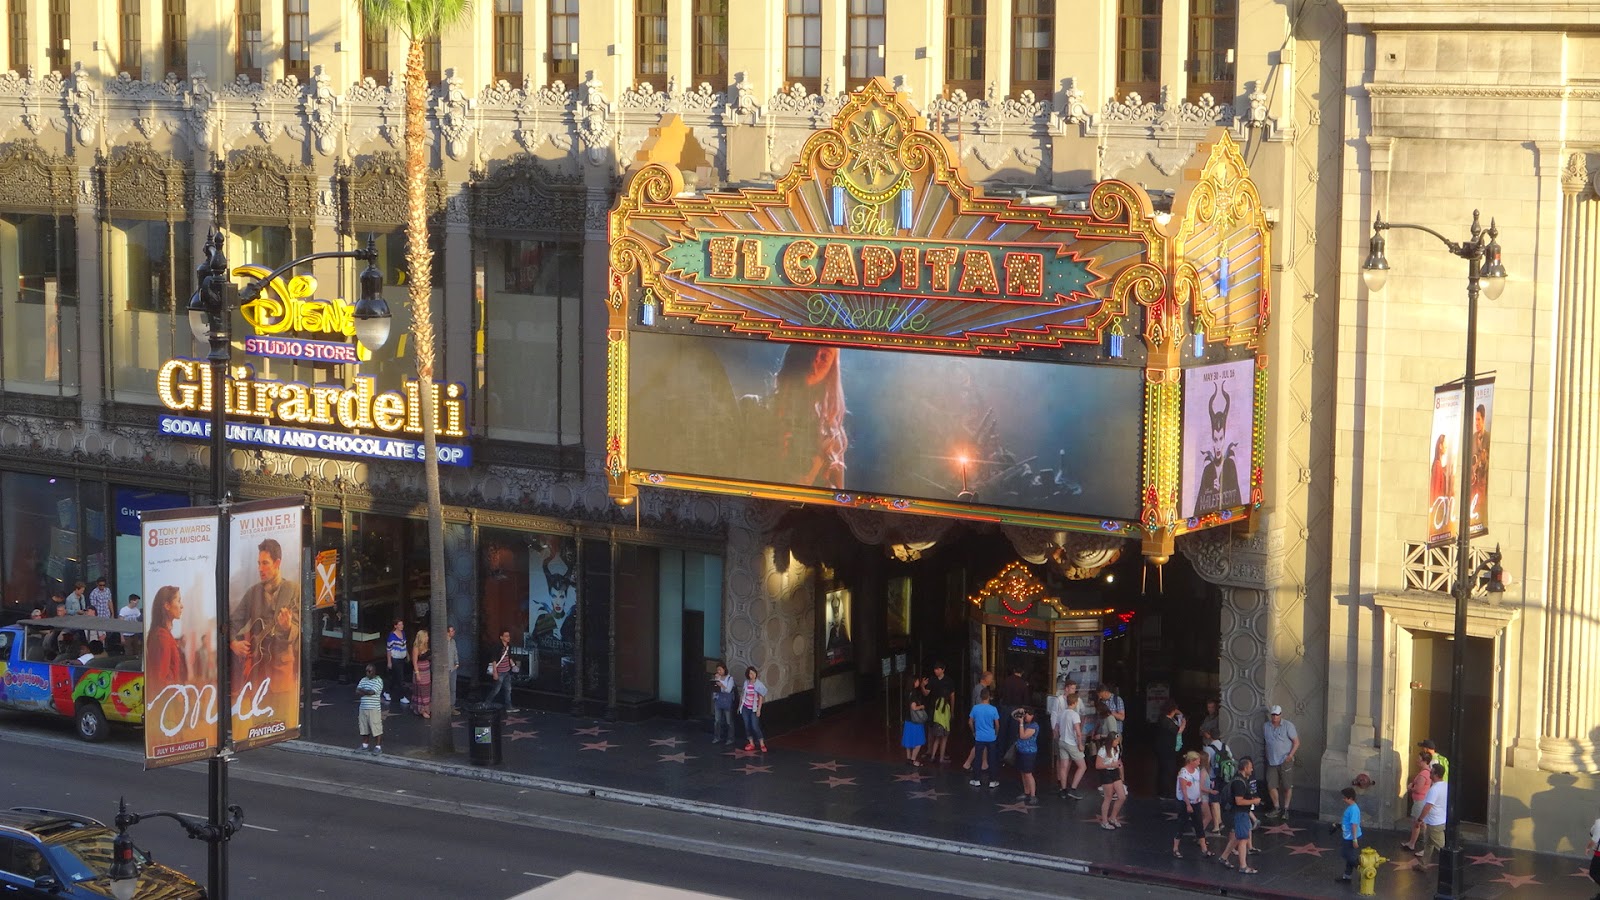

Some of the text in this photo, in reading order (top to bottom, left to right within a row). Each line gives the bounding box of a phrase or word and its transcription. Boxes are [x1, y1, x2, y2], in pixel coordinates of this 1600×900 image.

[850, 203, 896, 236] The
[708, 236, 1043, 297] EL CAPITAN
[807, 293, 931, 332] Theatre
[246, 339, 357, 361] STUDIO STORE
[157, 358, 467, 438] Ghirardelli
[161, 418, 204, 436] SODA
[205, 422, 280, 445] FUNTAIN
[282, 430, 317, 448] AND
[317, 433, 415, 460] CHOCOLATE
[158, 524, 211, 537] TONY AWARDS
[240, 513, 296, 530] WINNER!
[148, 528, 159, 548] 8
[158, 533, 211, 546] BEST MUSICAL
[248, 722, 286, 739] PANTAGES
[156, 747, 169, 755] JULY
